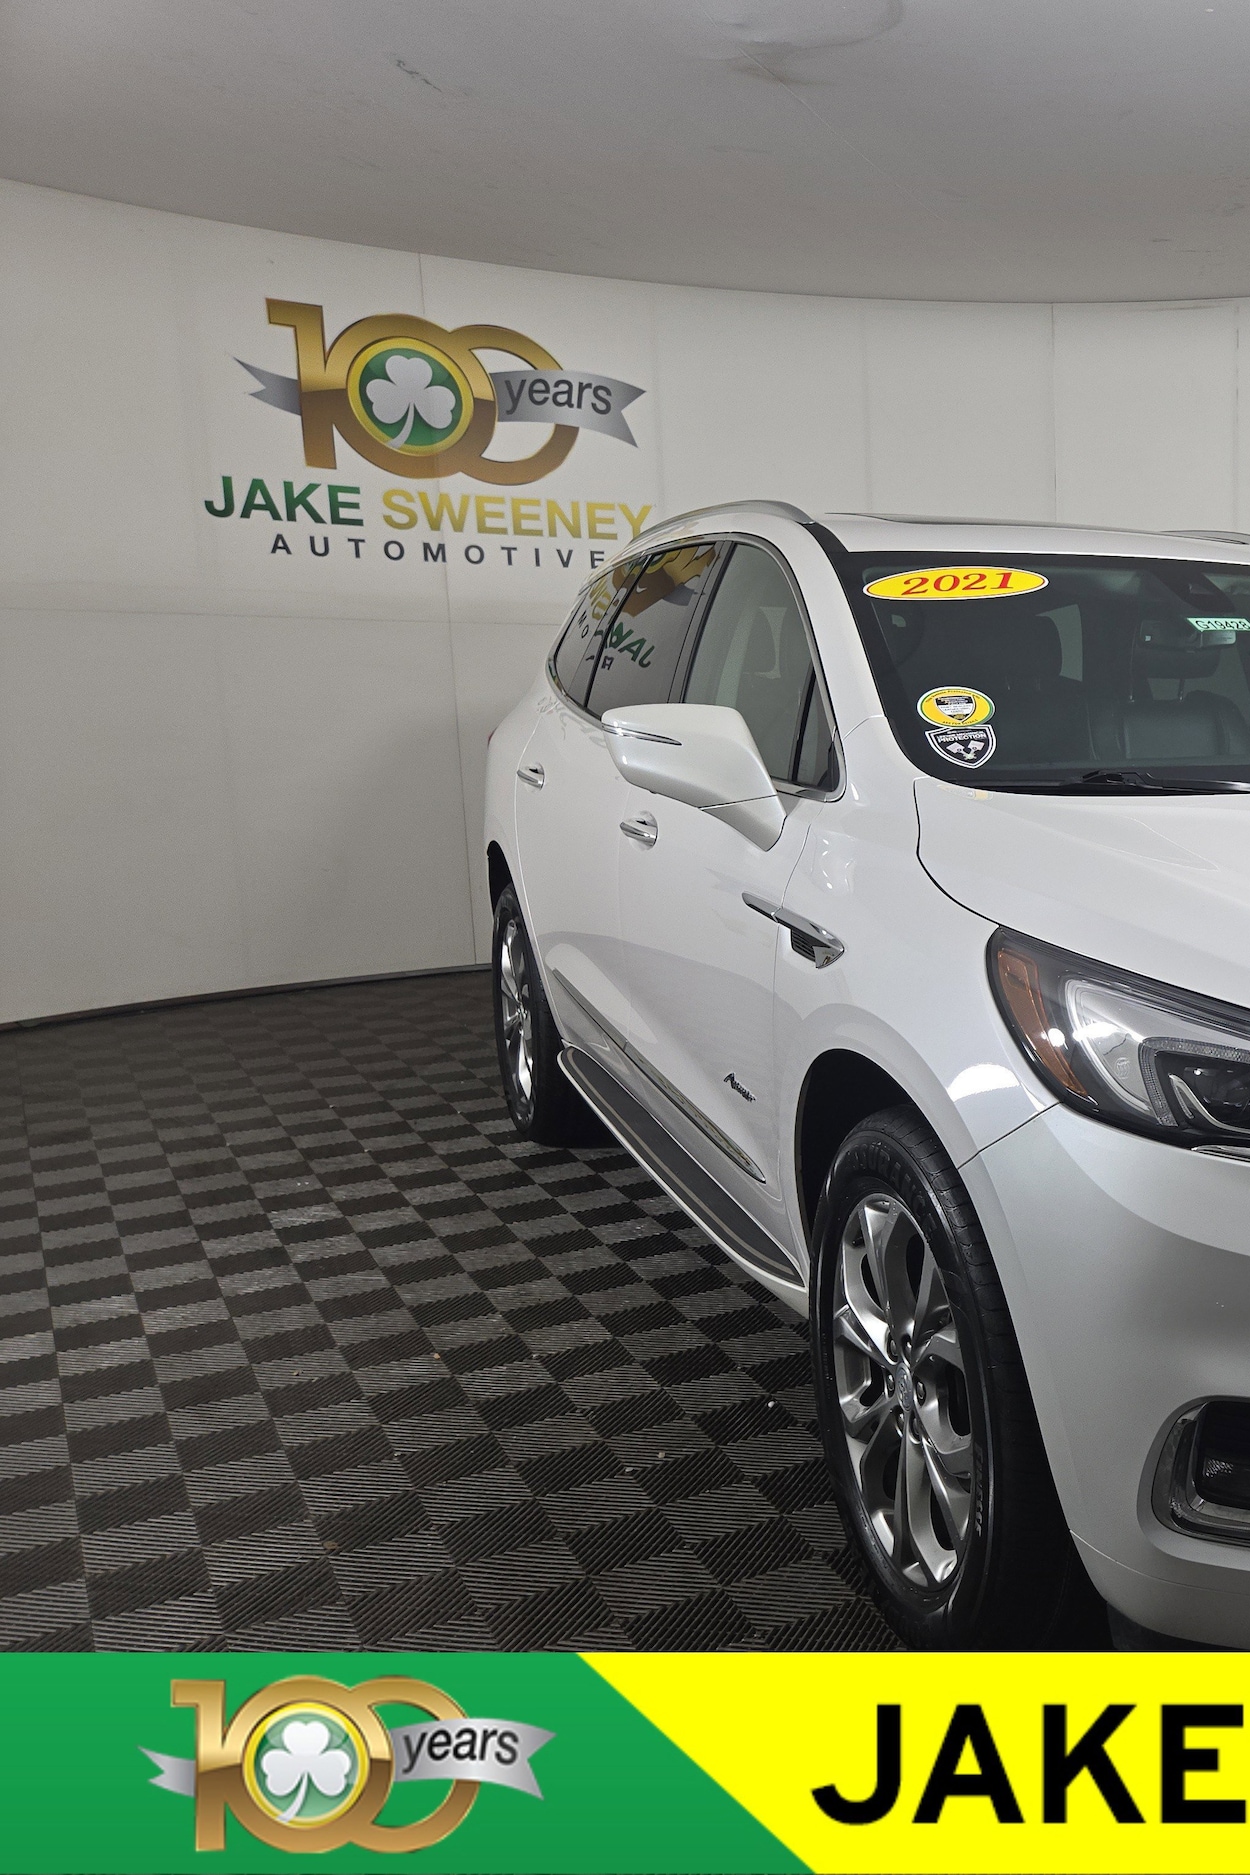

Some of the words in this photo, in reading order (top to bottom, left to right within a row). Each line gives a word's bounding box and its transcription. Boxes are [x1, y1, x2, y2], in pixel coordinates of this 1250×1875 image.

[504, 375, 614, 416] years
[204, 474, 365, 527] JAKE
[381, 487, 653, 541] SWEENEY
[269, 532, 606, 570] AUTOMOTIVE
[900, 571, 1014, 596] 2021
[1195, 620, 1250, 630] G19428
